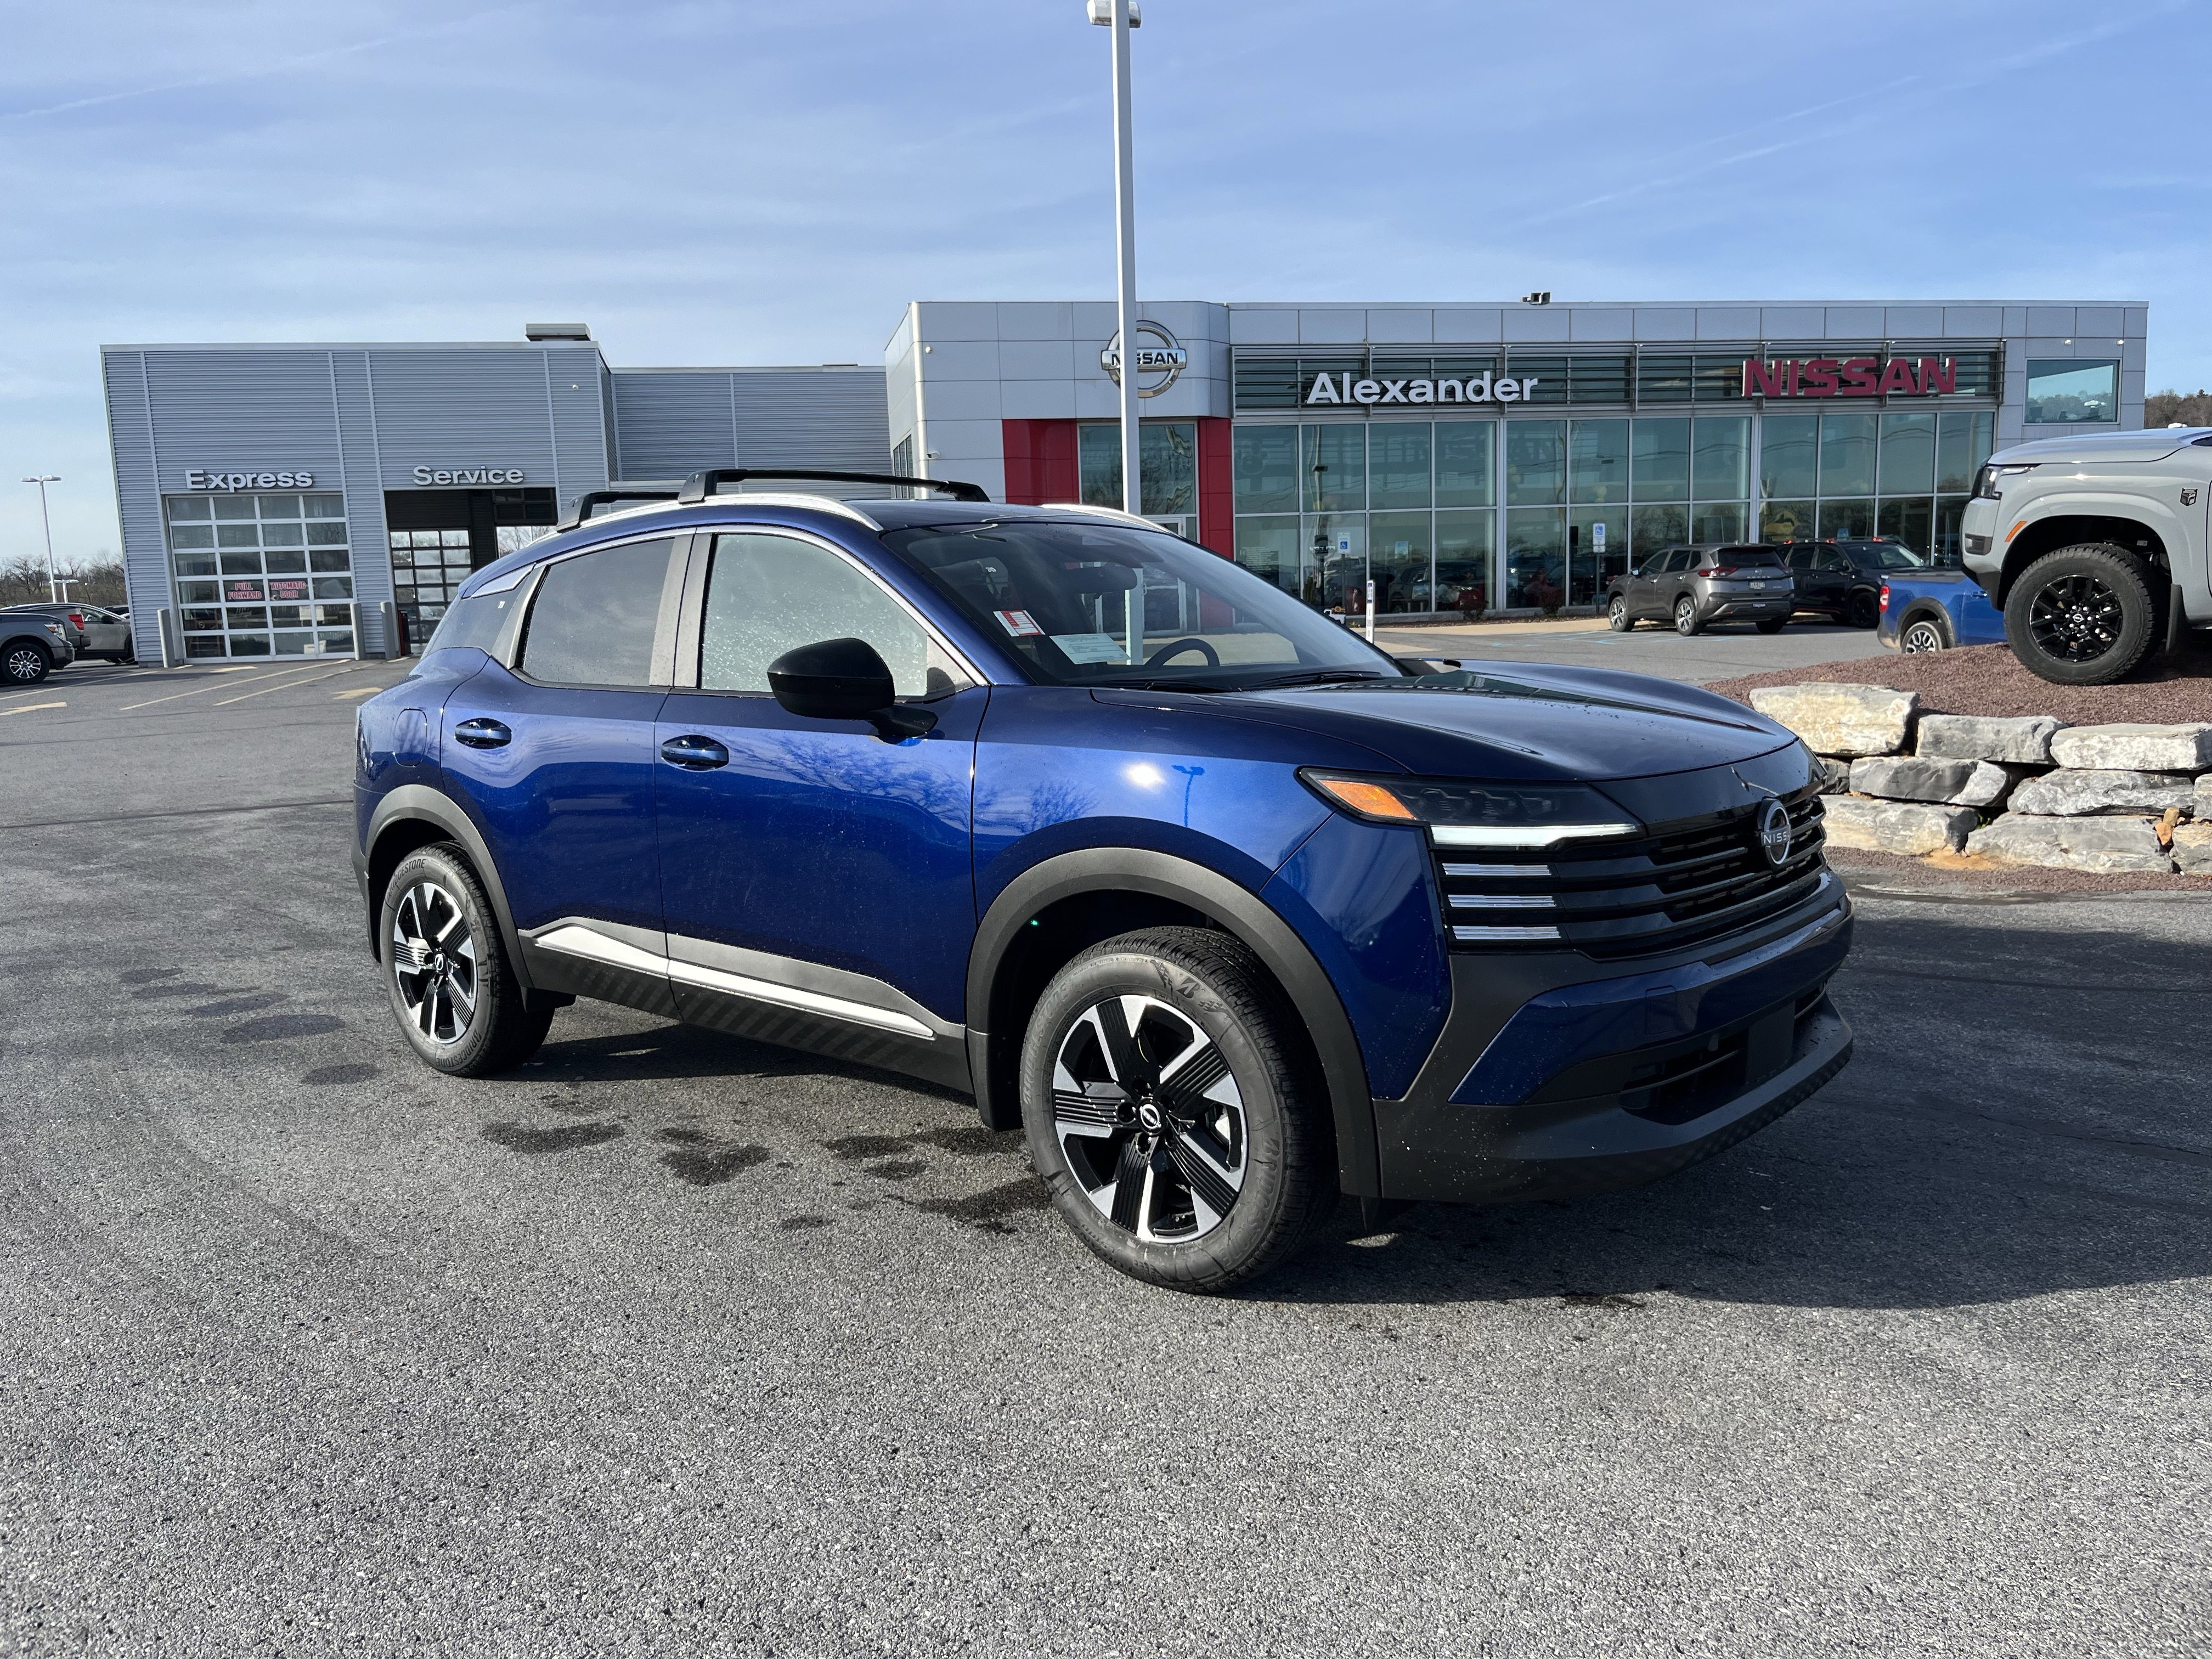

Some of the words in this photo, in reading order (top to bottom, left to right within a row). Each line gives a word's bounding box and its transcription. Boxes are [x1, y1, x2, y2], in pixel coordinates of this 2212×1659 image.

[1111, 352, 1178, 365] NSAN
[1742, 358, 1956, 397] NISSAN
[1306, 371, 1538, 404] Alexander
[185, 470, 313, 493] Express
[413, 465, 524, 486] Service
[235, 582, 253, 591] PULL
[271, 581, 306, 590] AUTOMATIC
[228, 590, 262, 600] FORWARD
[280, 590, 299, 599] DOOR
[1763, 831, 1788, 844] NISS
[436, 1026, 482, 1068] BRIDGESTONE
[1217, 1137, 1281, 1270] BRIDGESTONE
